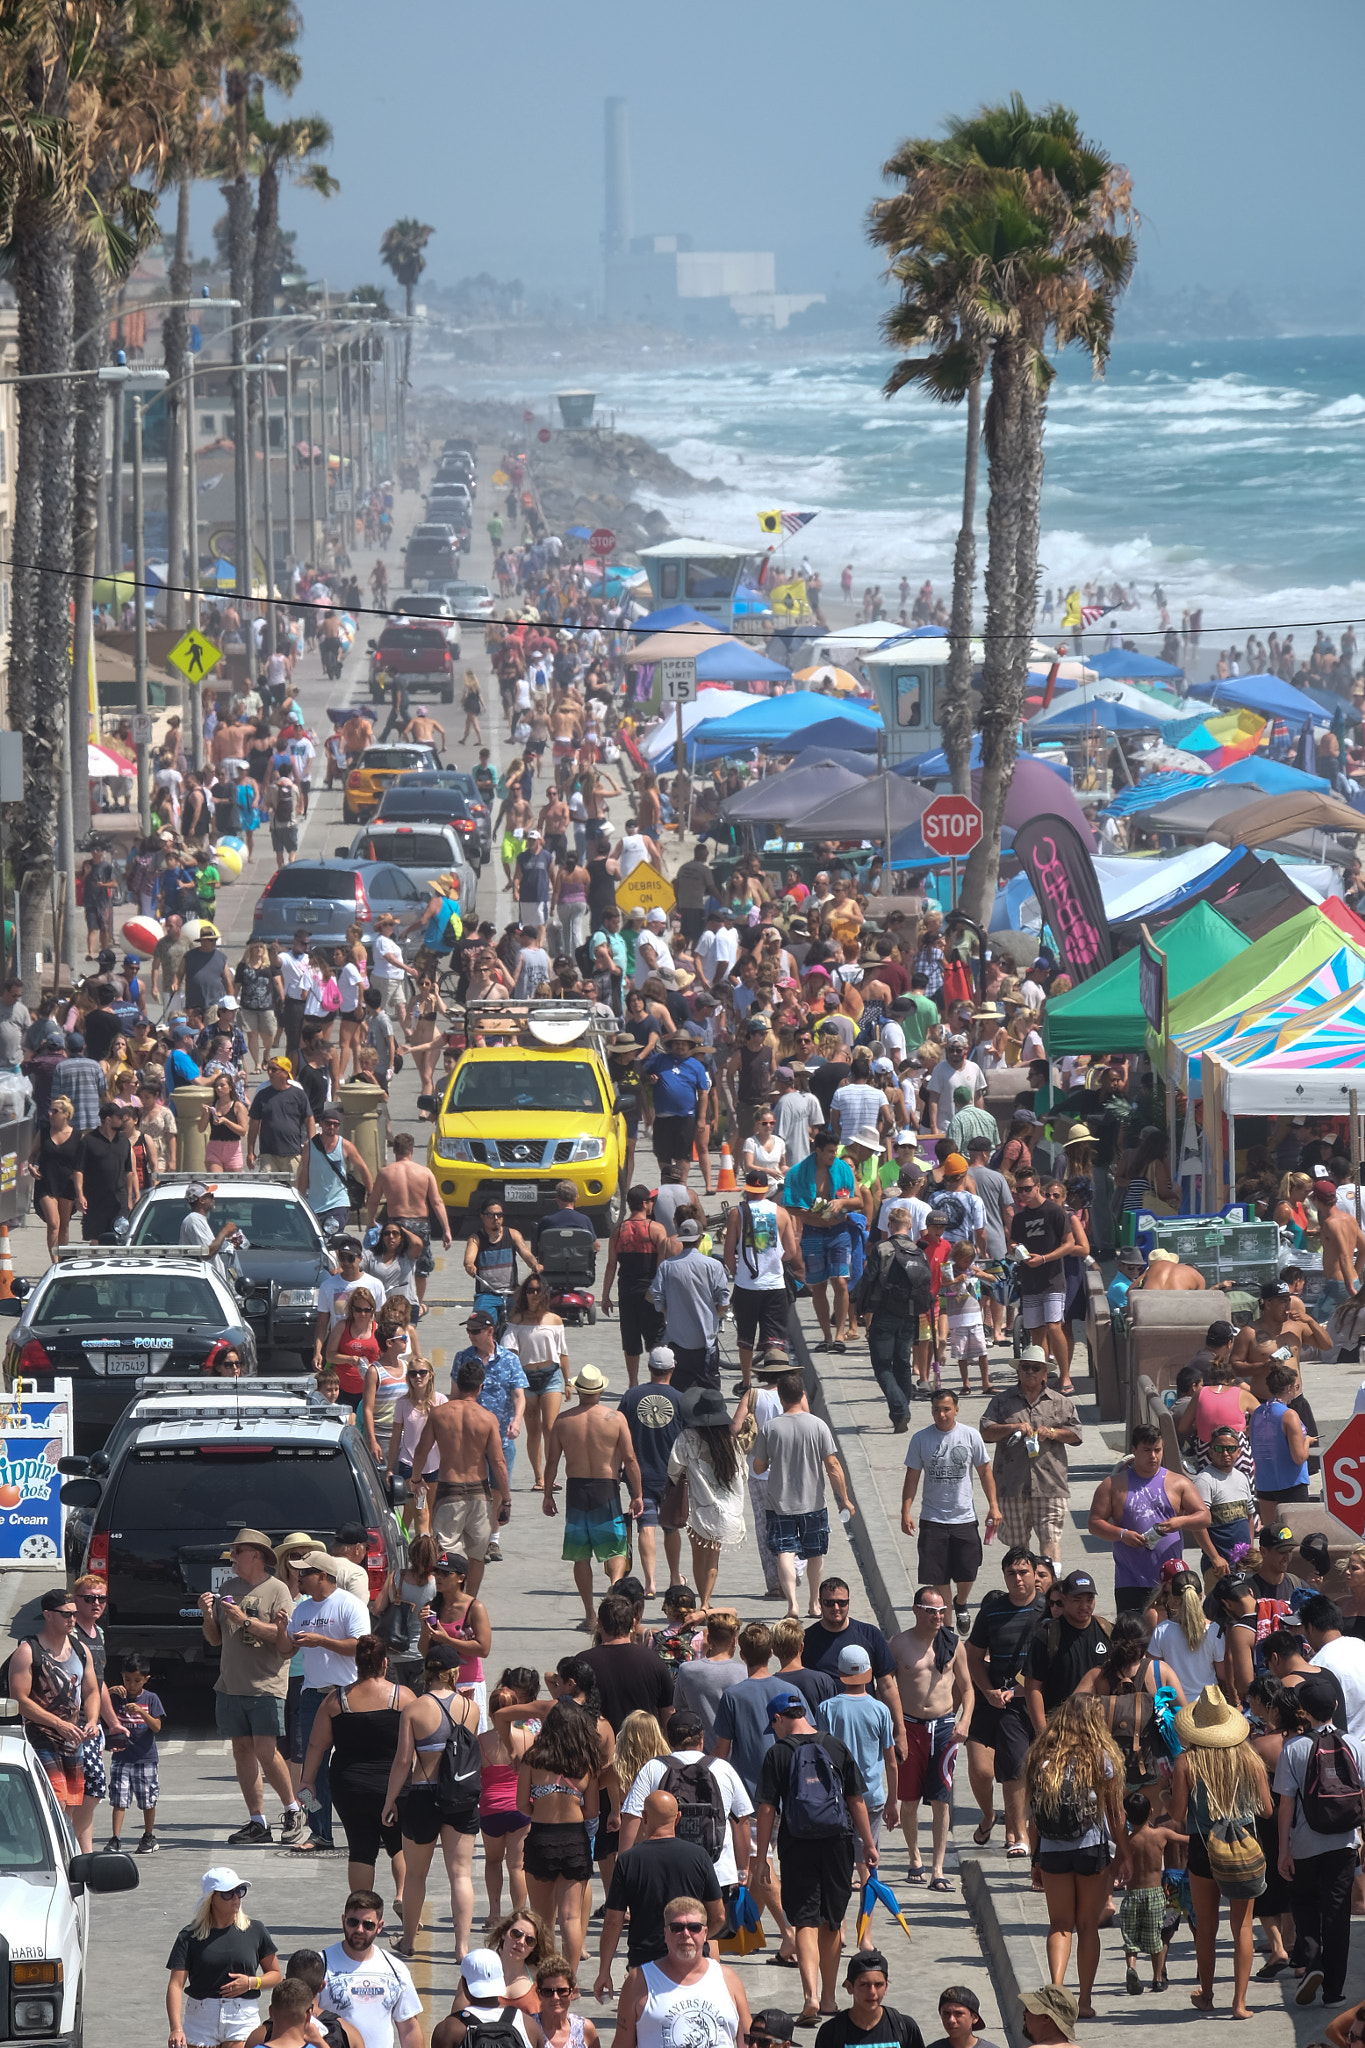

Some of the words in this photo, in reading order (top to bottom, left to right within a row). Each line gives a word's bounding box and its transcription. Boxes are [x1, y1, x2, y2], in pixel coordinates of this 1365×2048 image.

[591, 535, 615, 548] STOP
[663, 661, 695, 669] SPEED
[665, 671, 692, 679] LIMIT
[668, 681, 690, 698] 15
[926, 813, 979, 838] STOP
[627, 880, 662, 891] DEBRIS
[640, 893, 653, 904] ON
[134, 1337, 174, 1349] POLICE
[110, 1361, 145, 1372] 1275419
[19, 1484, 49, 1499] dots
[9, 1513, 48, 1525] Cream
[664, 1998, 700, 2021] MYERS
